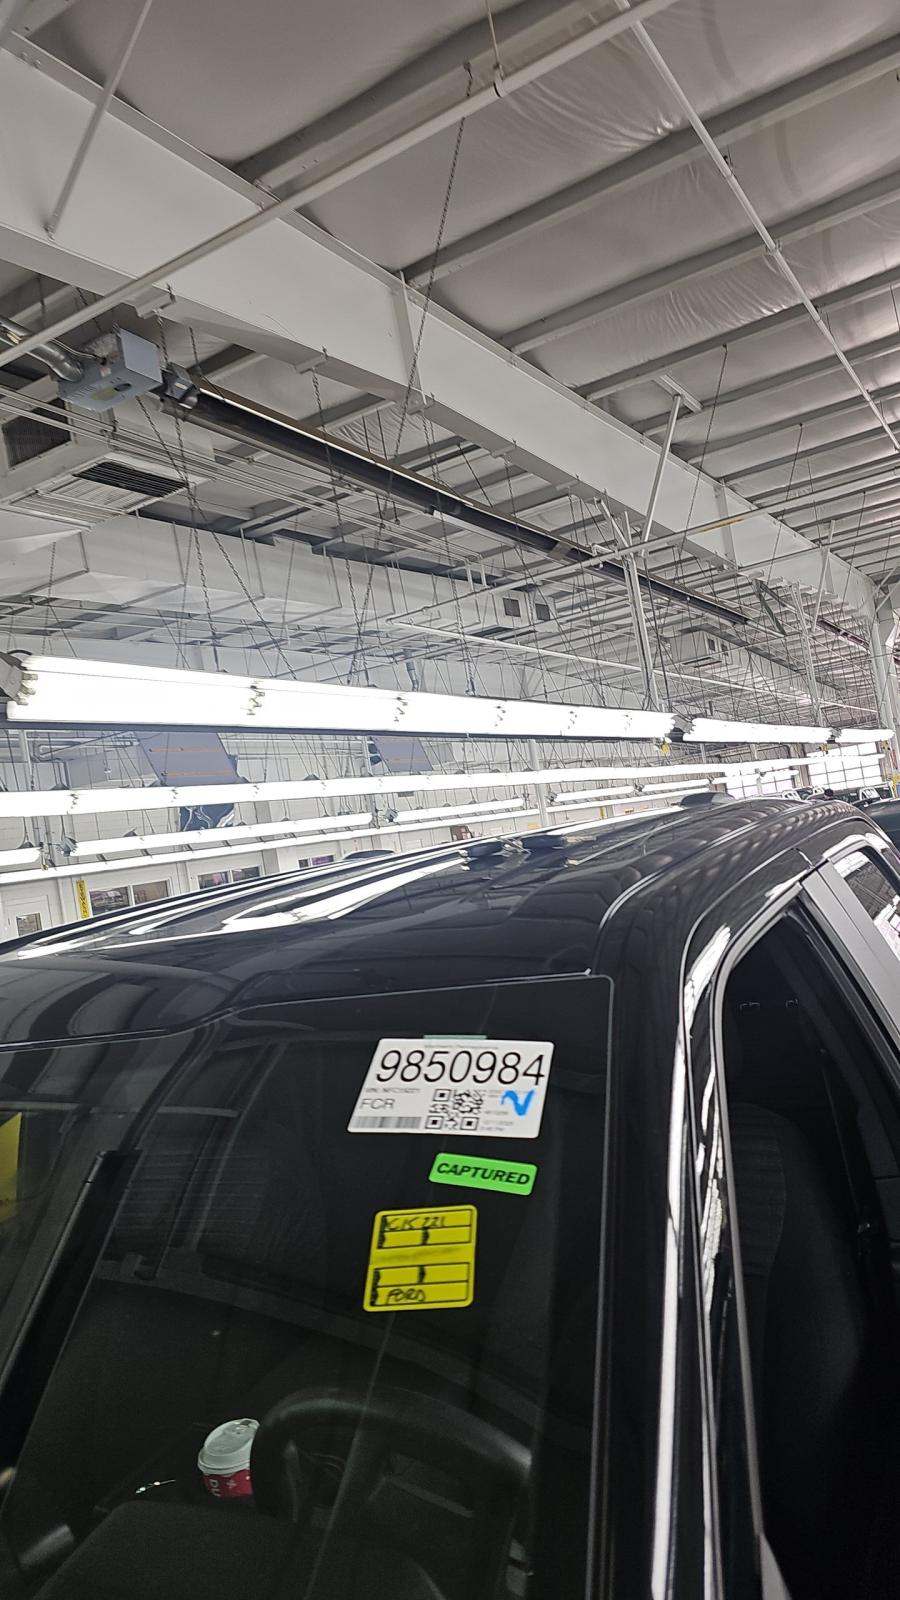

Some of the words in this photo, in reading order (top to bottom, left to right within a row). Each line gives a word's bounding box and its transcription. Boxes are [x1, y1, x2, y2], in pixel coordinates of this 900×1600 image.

[377, 1050, 545, 1086] 9850984
[360, 1098, 396, 1110] FCR
[437, 1163, 530, 1184] CAPTURED
